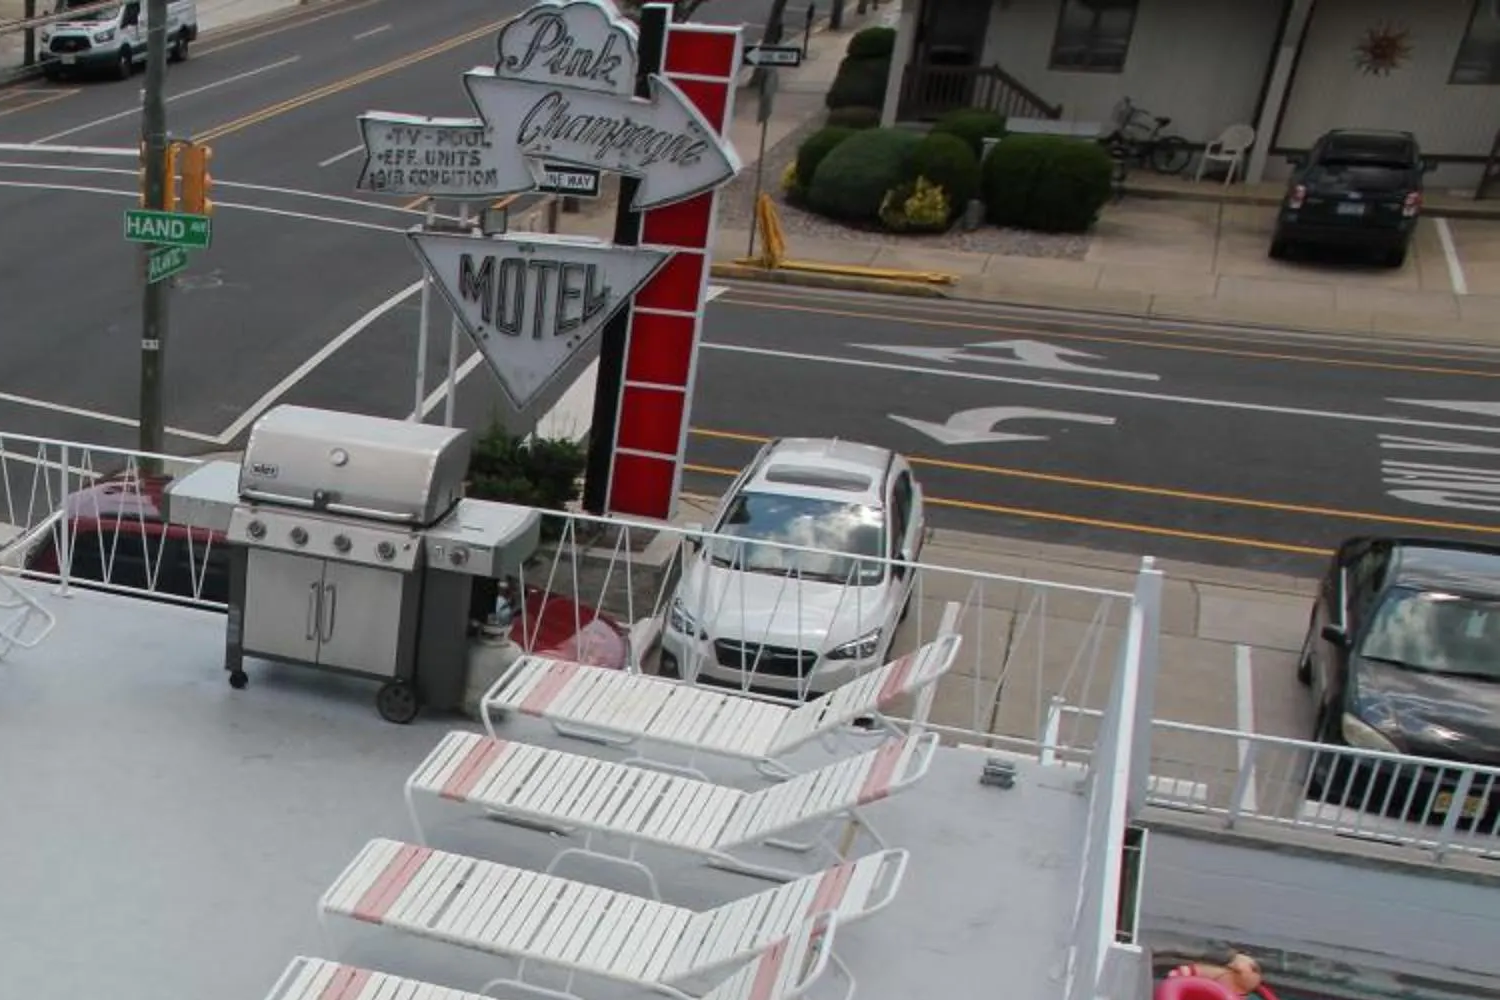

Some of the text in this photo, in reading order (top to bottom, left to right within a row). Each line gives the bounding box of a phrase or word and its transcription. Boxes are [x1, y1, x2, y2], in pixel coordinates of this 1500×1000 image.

[506, 12, 623, 87] Pink
[516, 90, 709, 168] Champagne
[425, 149, 482, 167] UNITS
[408, 168, 497, 186] CONDITION
[567, 175, 591, 187] WAY
[127, 215, 185, 239] HAND
[458, 253, 611, 340] MOTEL
